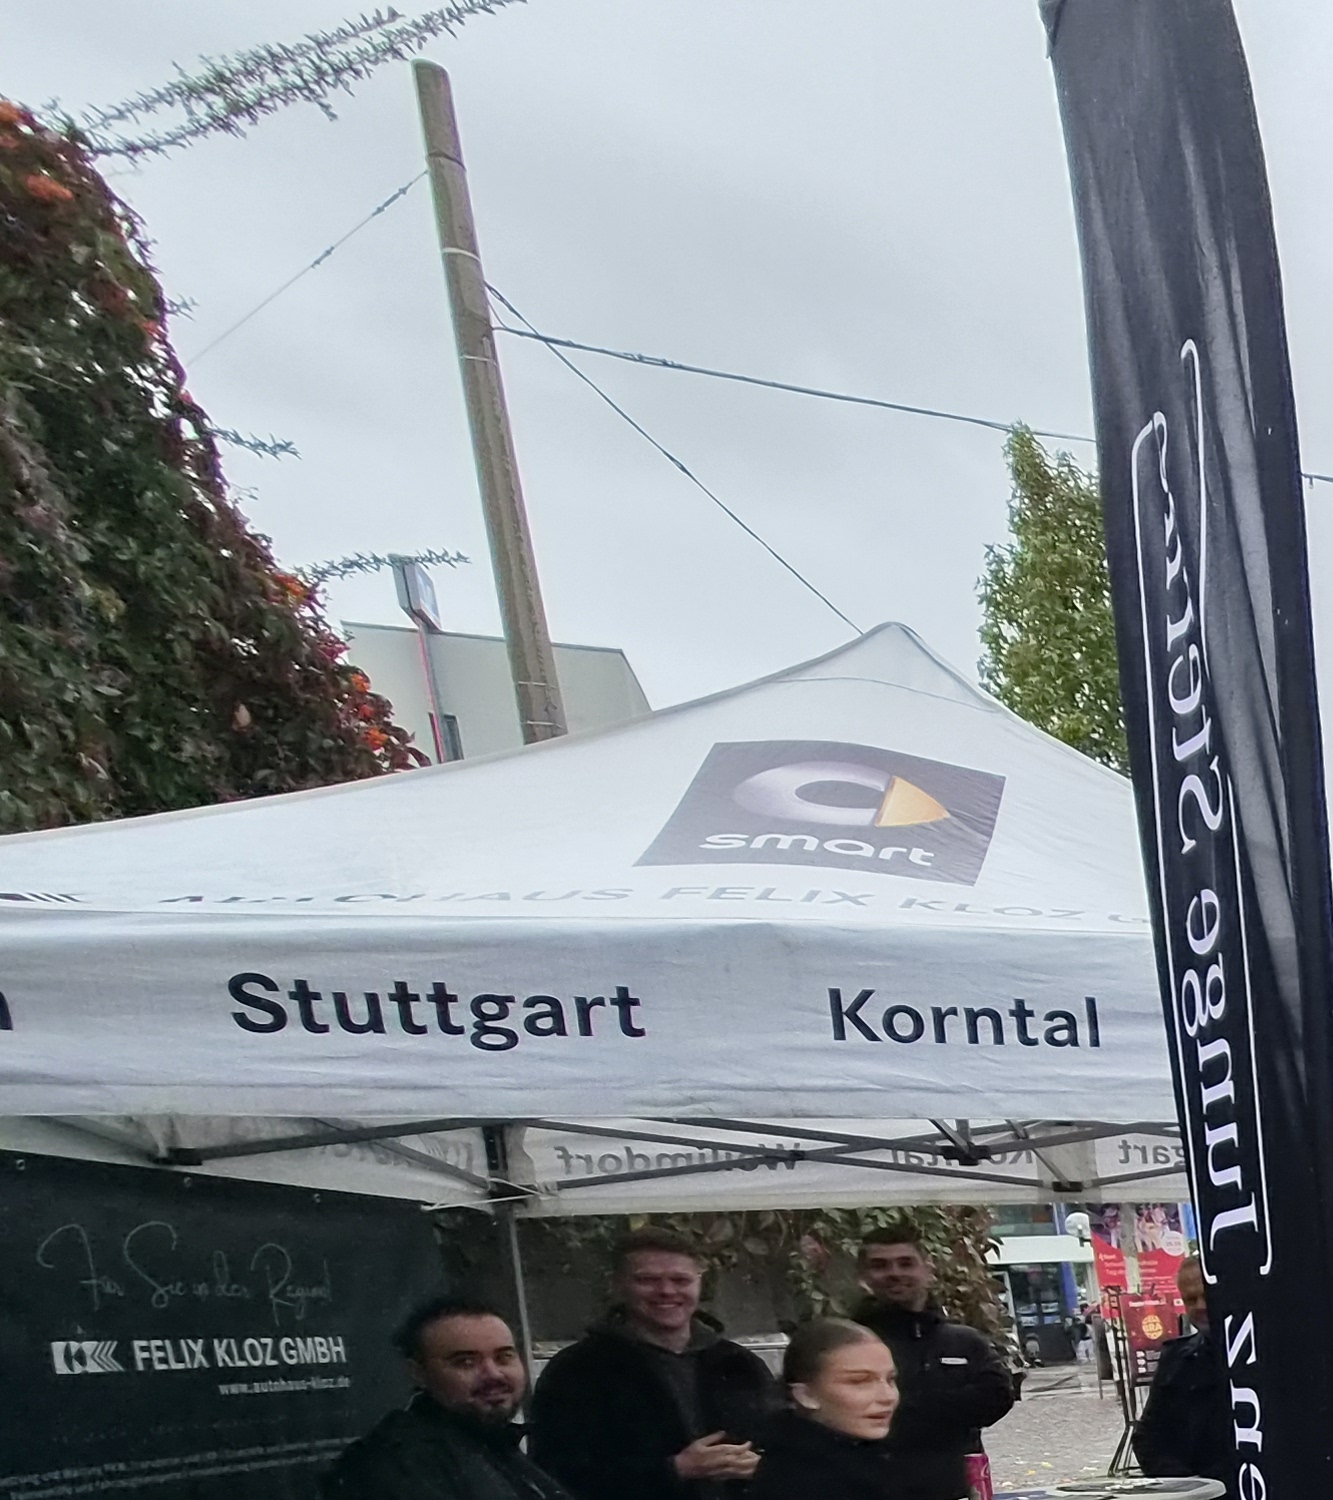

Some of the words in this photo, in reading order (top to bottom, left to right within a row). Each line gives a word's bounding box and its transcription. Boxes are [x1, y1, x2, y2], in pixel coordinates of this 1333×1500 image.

[699, 833, 935, 866] smart
[660, 886, 876, 906] FELIX
[898, 898, 1086, 921] KLOZ
[227, 972, 646, 1051] Stuttgart
[828, 987, 1101, 1048] Korntal
[131, 1338, 210, 1371] FELIX
[213, 1337, 280, 1368] KLOZ
[279, 1335, 347, 1365] GMBH
